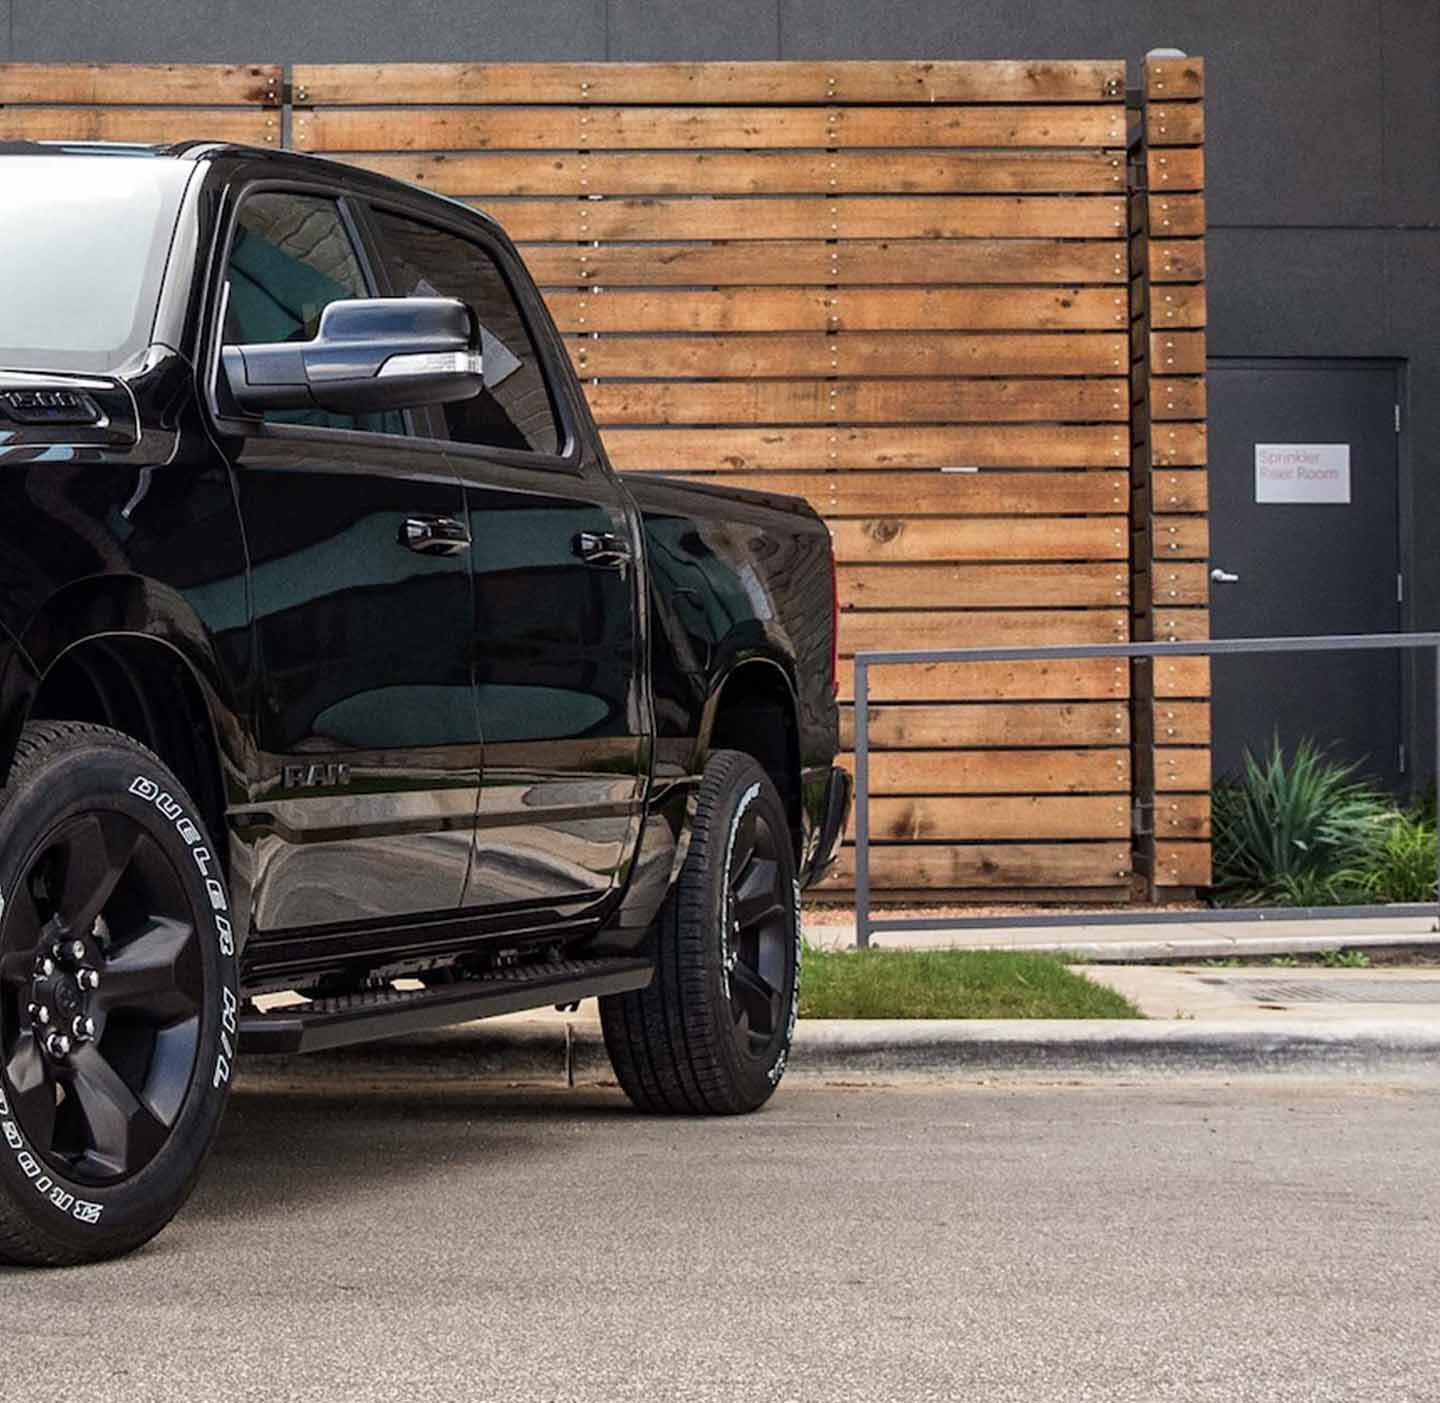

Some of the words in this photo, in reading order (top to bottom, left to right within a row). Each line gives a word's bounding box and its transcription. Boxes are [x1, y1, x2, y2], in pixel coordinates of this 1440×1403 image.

[5, 391, 84, 408] 1500
[1297, 466, 1340, 480] Room
[282, 763, 353, 787] RAM
[129, 776, 235, 957] DUELER
